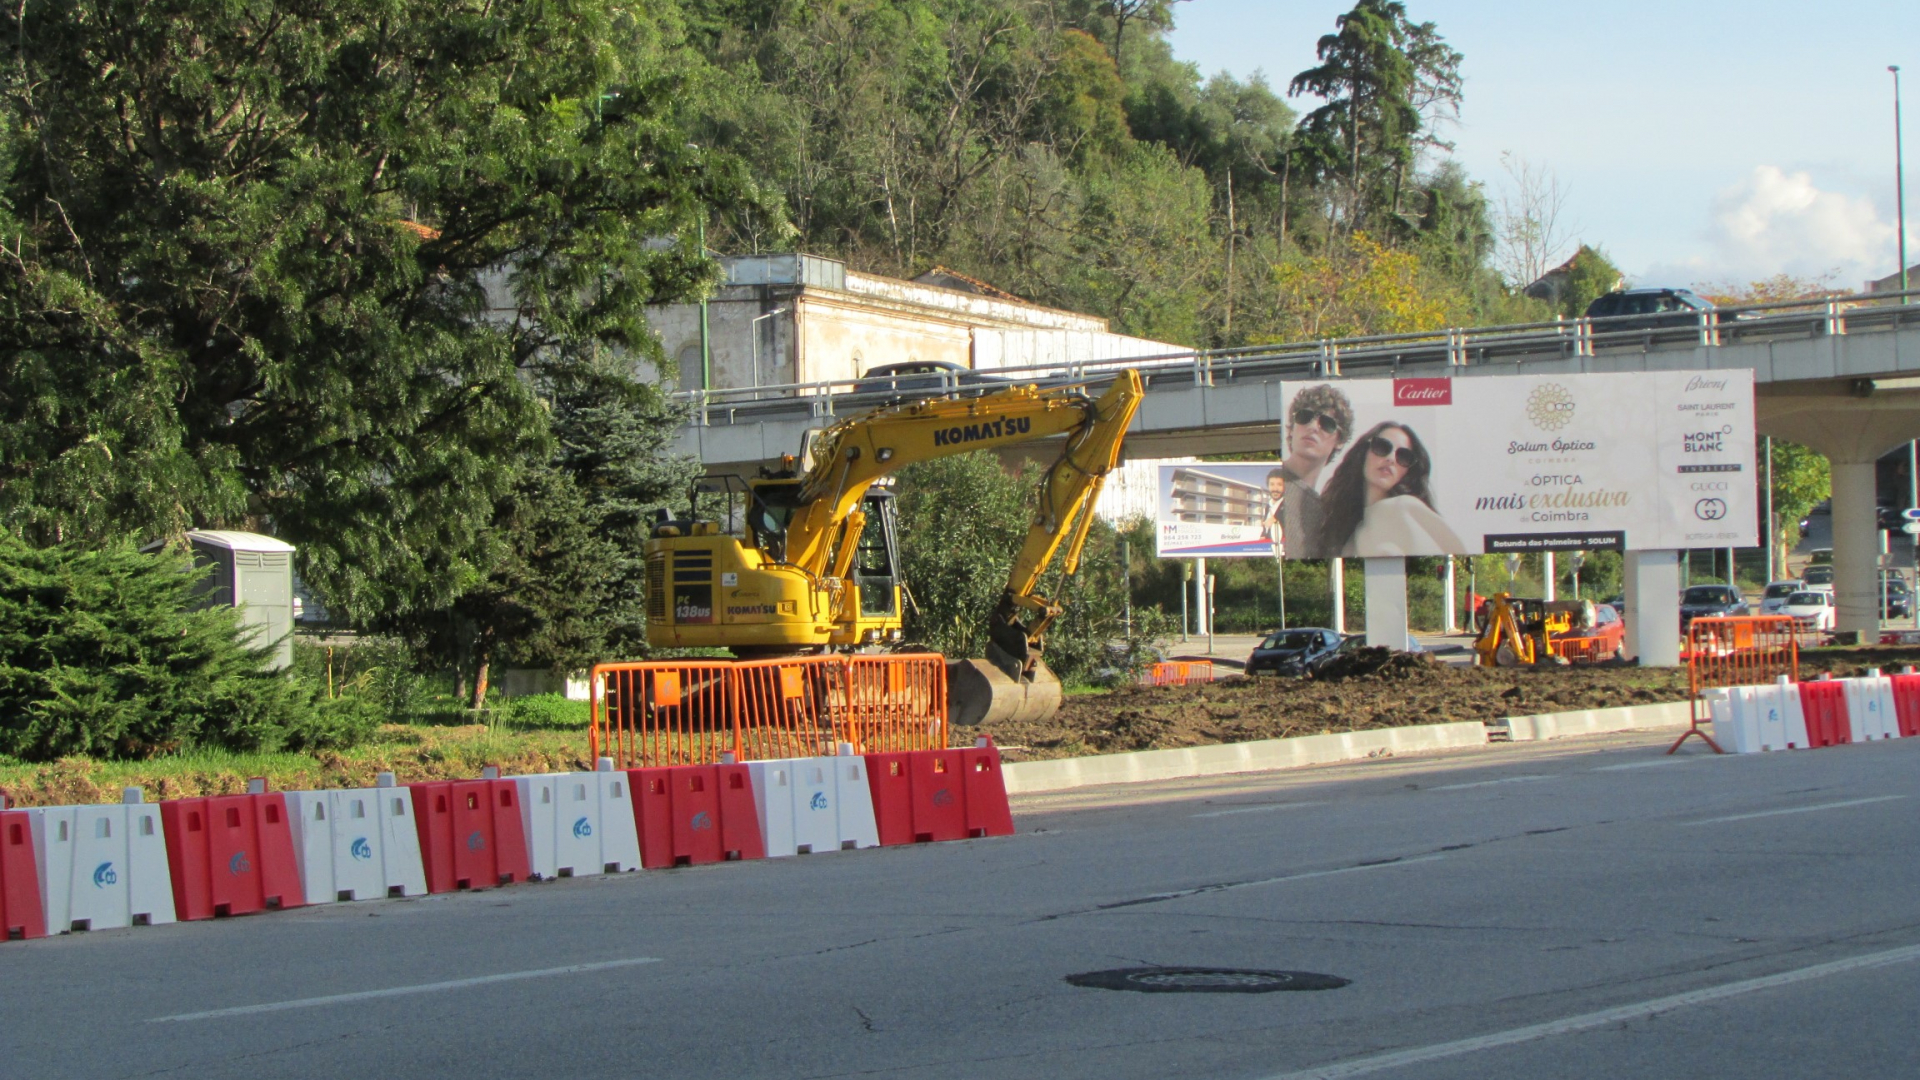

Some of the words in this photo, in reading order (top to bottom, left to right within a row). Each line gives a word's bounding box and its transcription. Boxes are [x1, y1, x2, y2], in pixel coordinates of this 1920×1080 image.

[1398, 384, 1448, 399] Cartier
[1701, 403, 1735, 411] LAURENT
[934, 415, 1030, 447] KOMATSU
[1684, 431, 1722, 442] MONT
[1507, 440, 1549, 454] Solum
[1551, 437, 1596, 454] Óptica
[1684, 442, 1723, 453] BLANC
[1531, 474, 1583, 487] ÓPTICA
[1690, 482, 1728, 492] GUCCI
[1475, 493, 1527, 511] mais
[1529, 486, 1631, 510] exclusiva
[1531, 511, 1589, 522] Coimbra
[1494, 540, 1526, 548] Rotunda
[1544, 538, 1582, 547] Palmeiras
[1588, 537, 1616, 545] SOLUM
[677, 596, 691, 605] PC
[727, 603, 776, 615] KOMATSU
